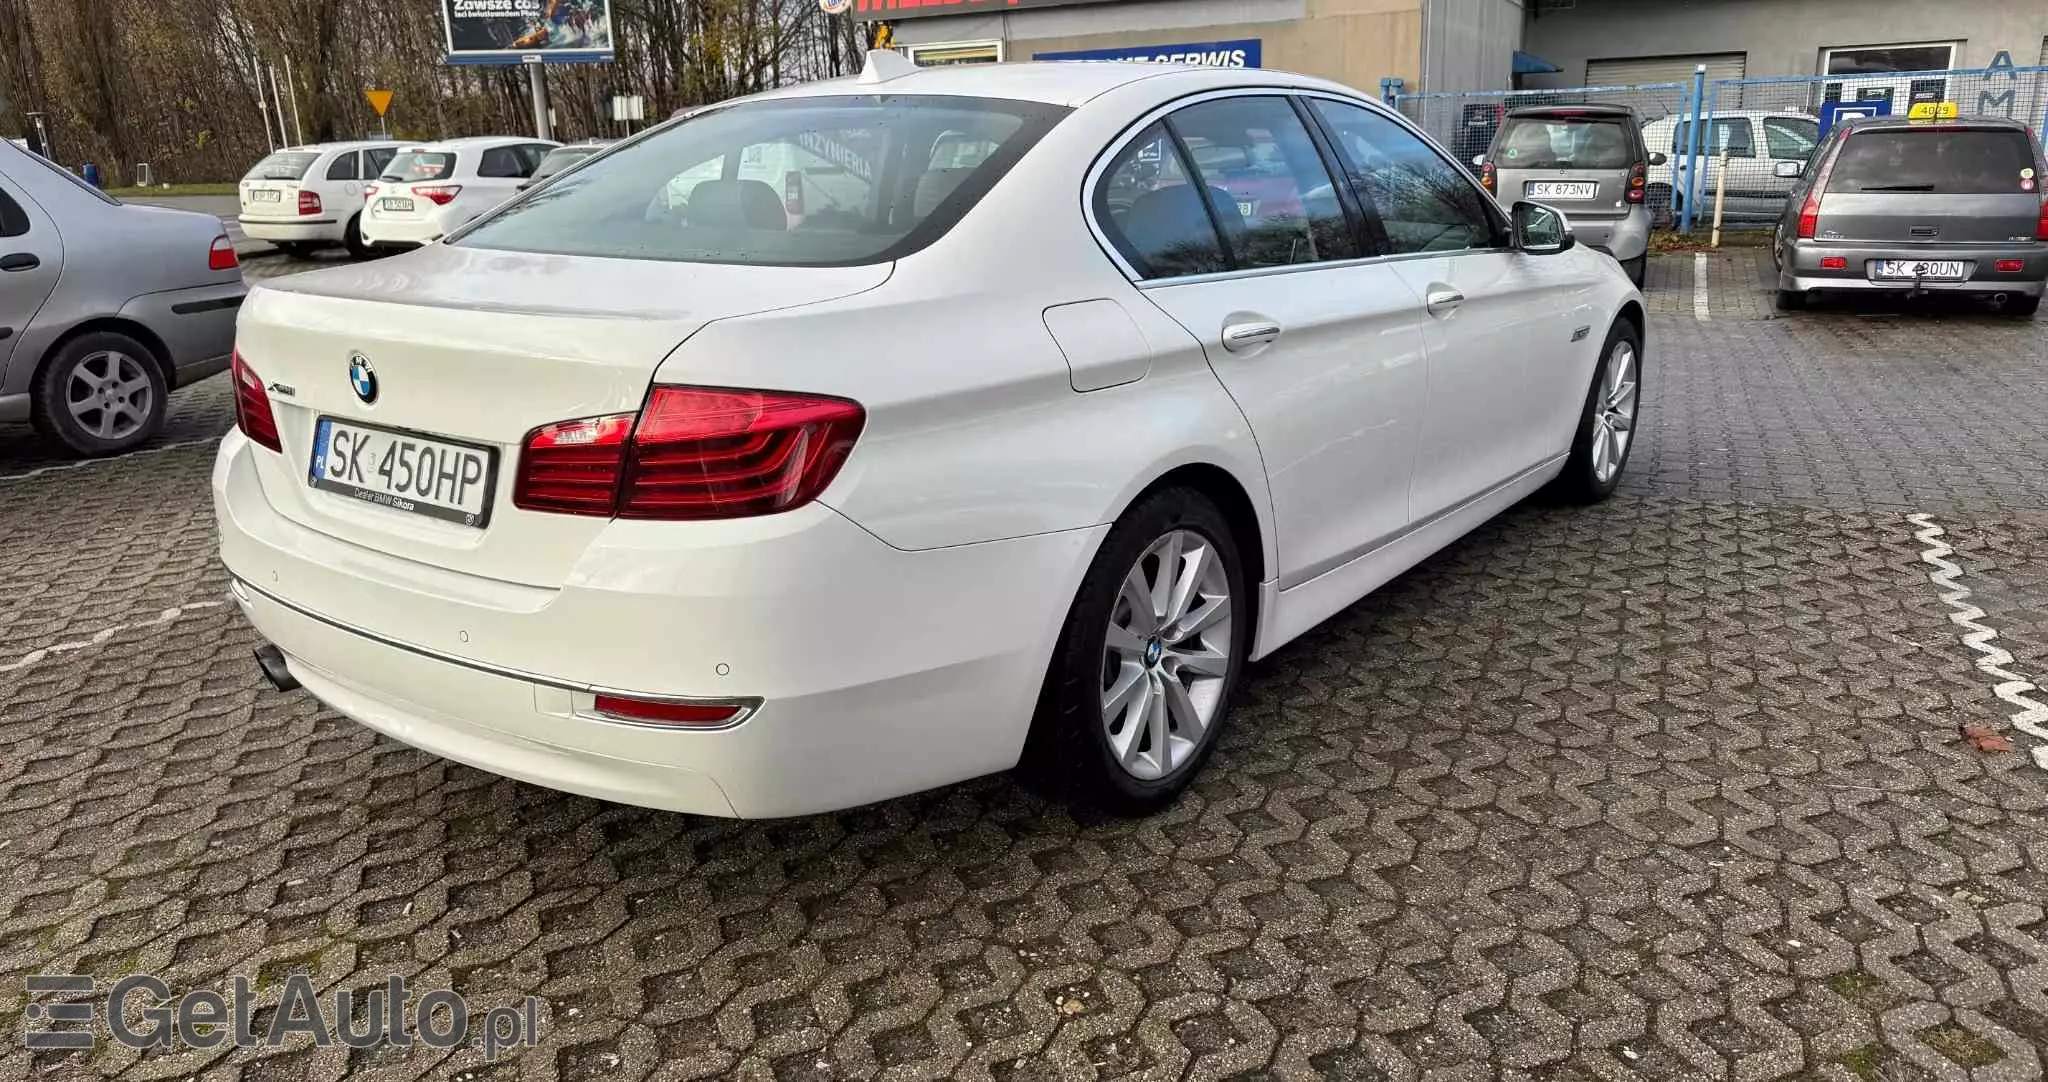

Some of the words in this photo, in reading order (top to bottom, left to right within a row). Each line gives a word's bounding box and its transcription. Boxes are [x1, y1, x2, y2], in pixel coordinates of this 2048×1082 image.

[454, 0, 512, 10] Zawsze
[1537, 183, 1551, 195] SK
[1556, 183, 1592, 195] 873NV
[1886, 261, 1905, 276] SK
[316, 455, 325, 469] PL
[331, 430, 370, 483] SK
[379, 440, 482, 505] 450HP
[374, 492, 393, 505] BMW
